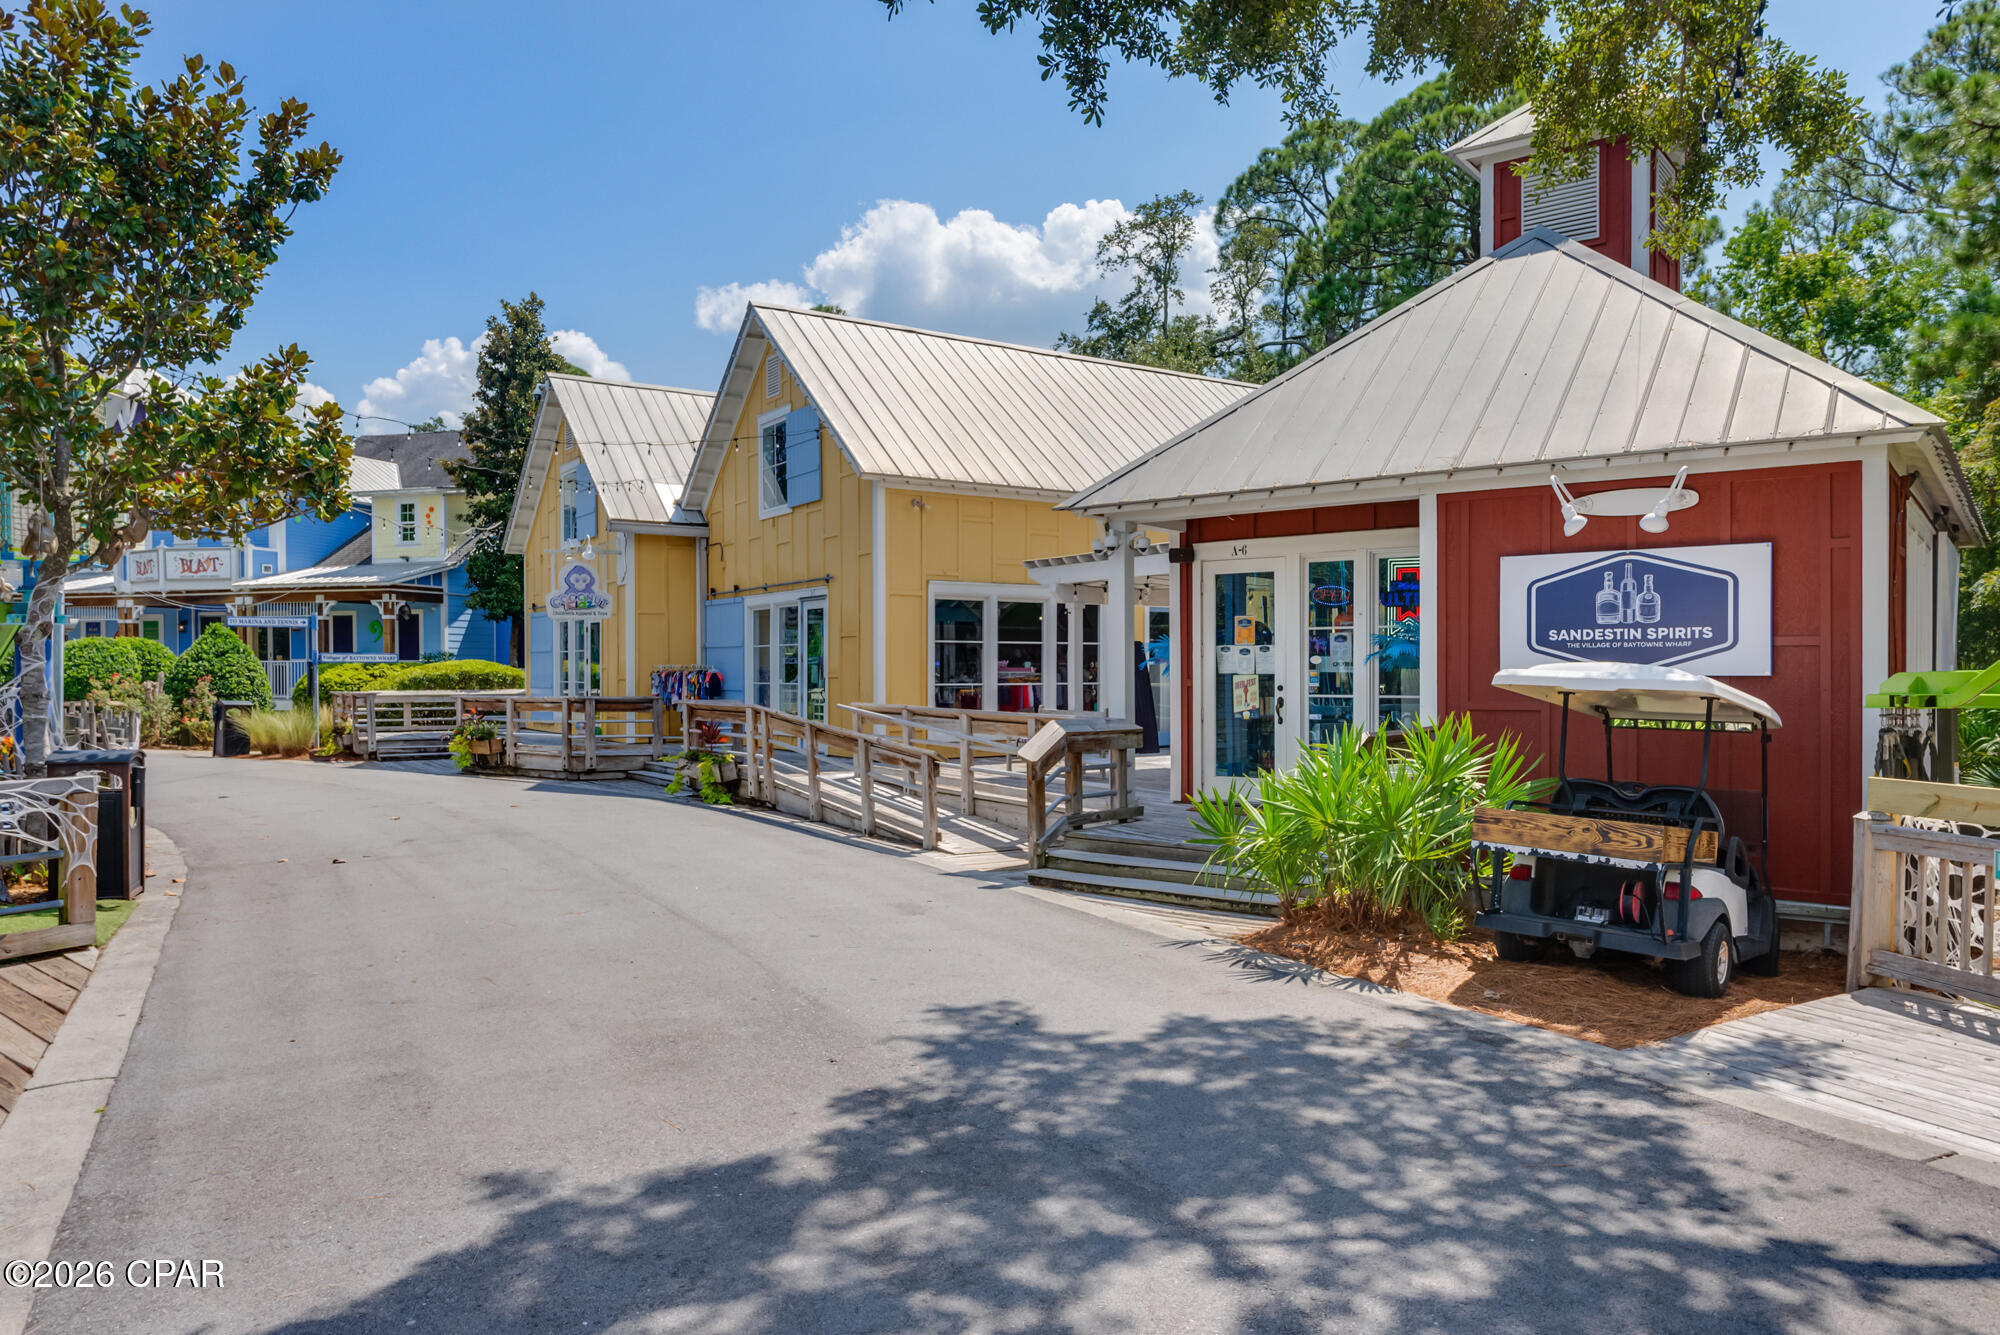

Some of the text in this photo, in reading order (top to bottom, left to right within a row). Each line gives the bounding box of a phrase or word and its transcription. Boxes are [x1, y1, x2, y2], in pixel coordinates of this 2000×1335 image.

[1312, 588, 1352, 602] OPEN
[1380, 591, 1420, 607] ULT
[229, 618, 299, 626] TO MARINA AND TENNIS
[1548, 626, 1713, 641] SANDESTIN SPIRITS
